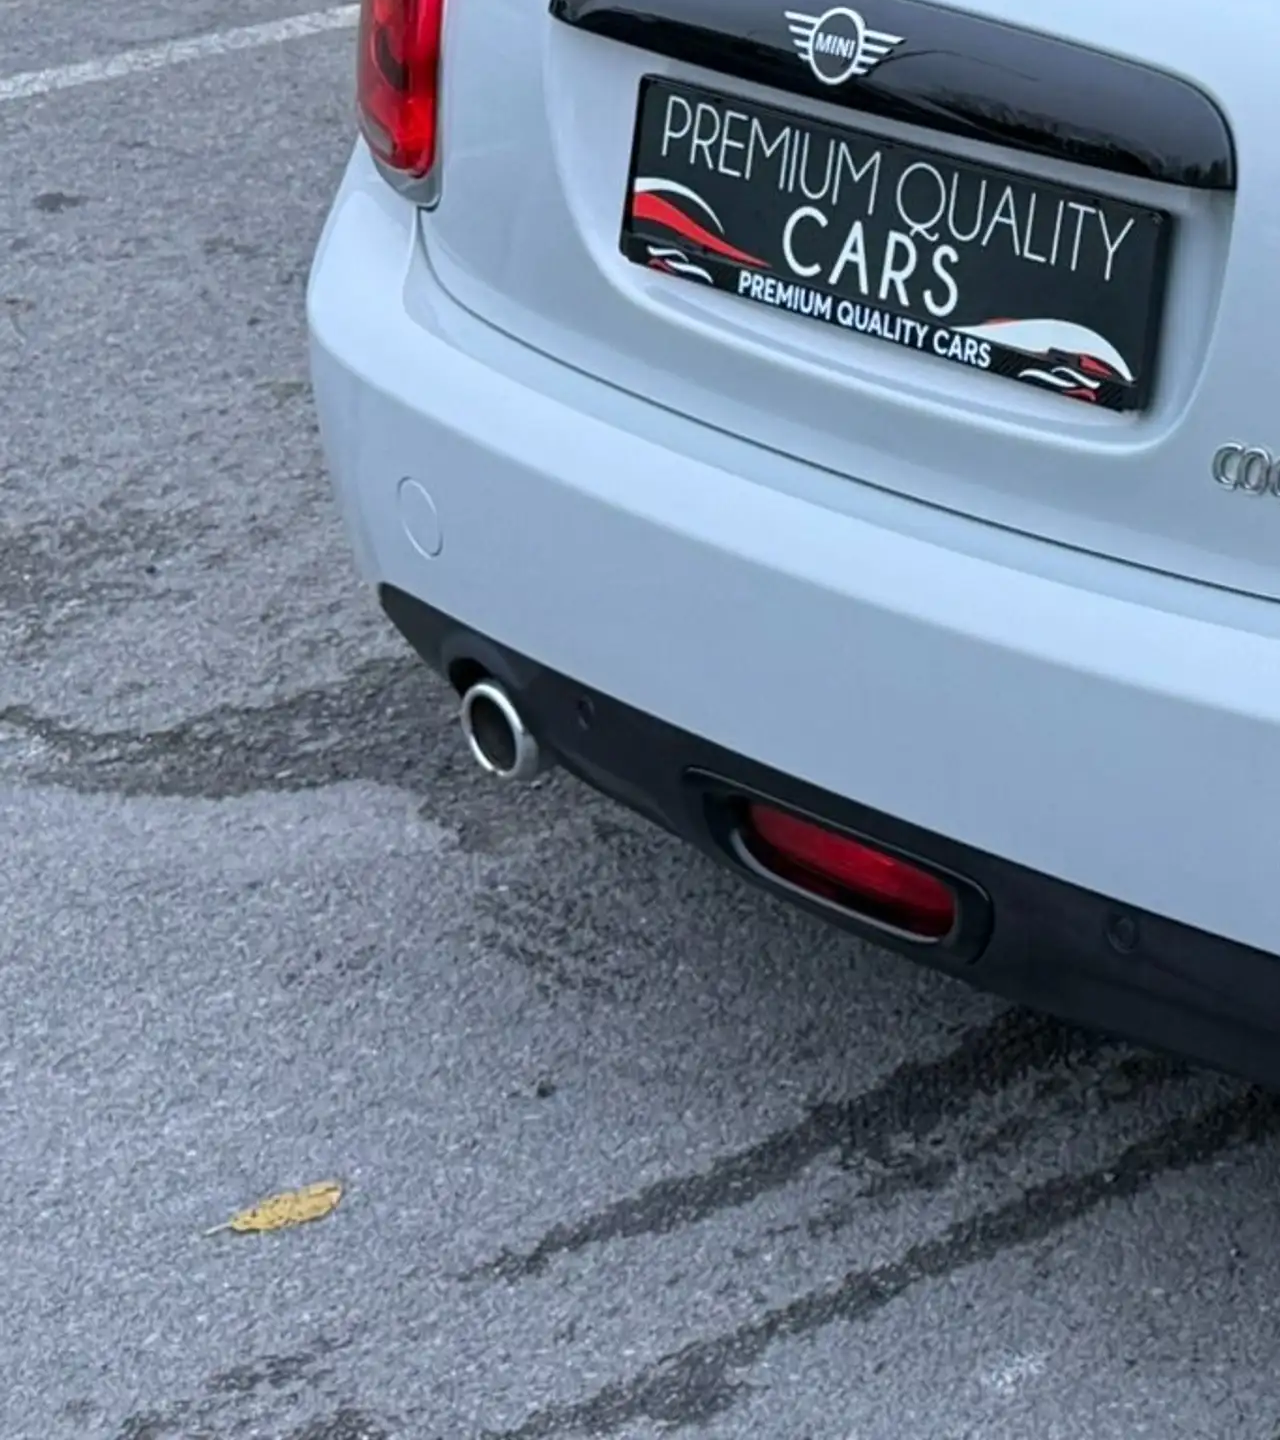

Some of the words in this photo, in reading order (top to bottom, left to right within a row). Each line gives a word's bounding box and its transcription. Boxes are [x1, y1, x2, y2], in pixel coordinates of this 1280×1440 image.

[815, 32, 856, 61] MINI
[661, 95, 882, 214] PREMIUM
[895, 161, 1135, 282] QUALITY
[782, 206, 960, 318] CARS
[738, 270, 833, 321] PREMIUM
[835, 300, 930, 350] QUALITY
[933, 329, 992, 368] CARS
